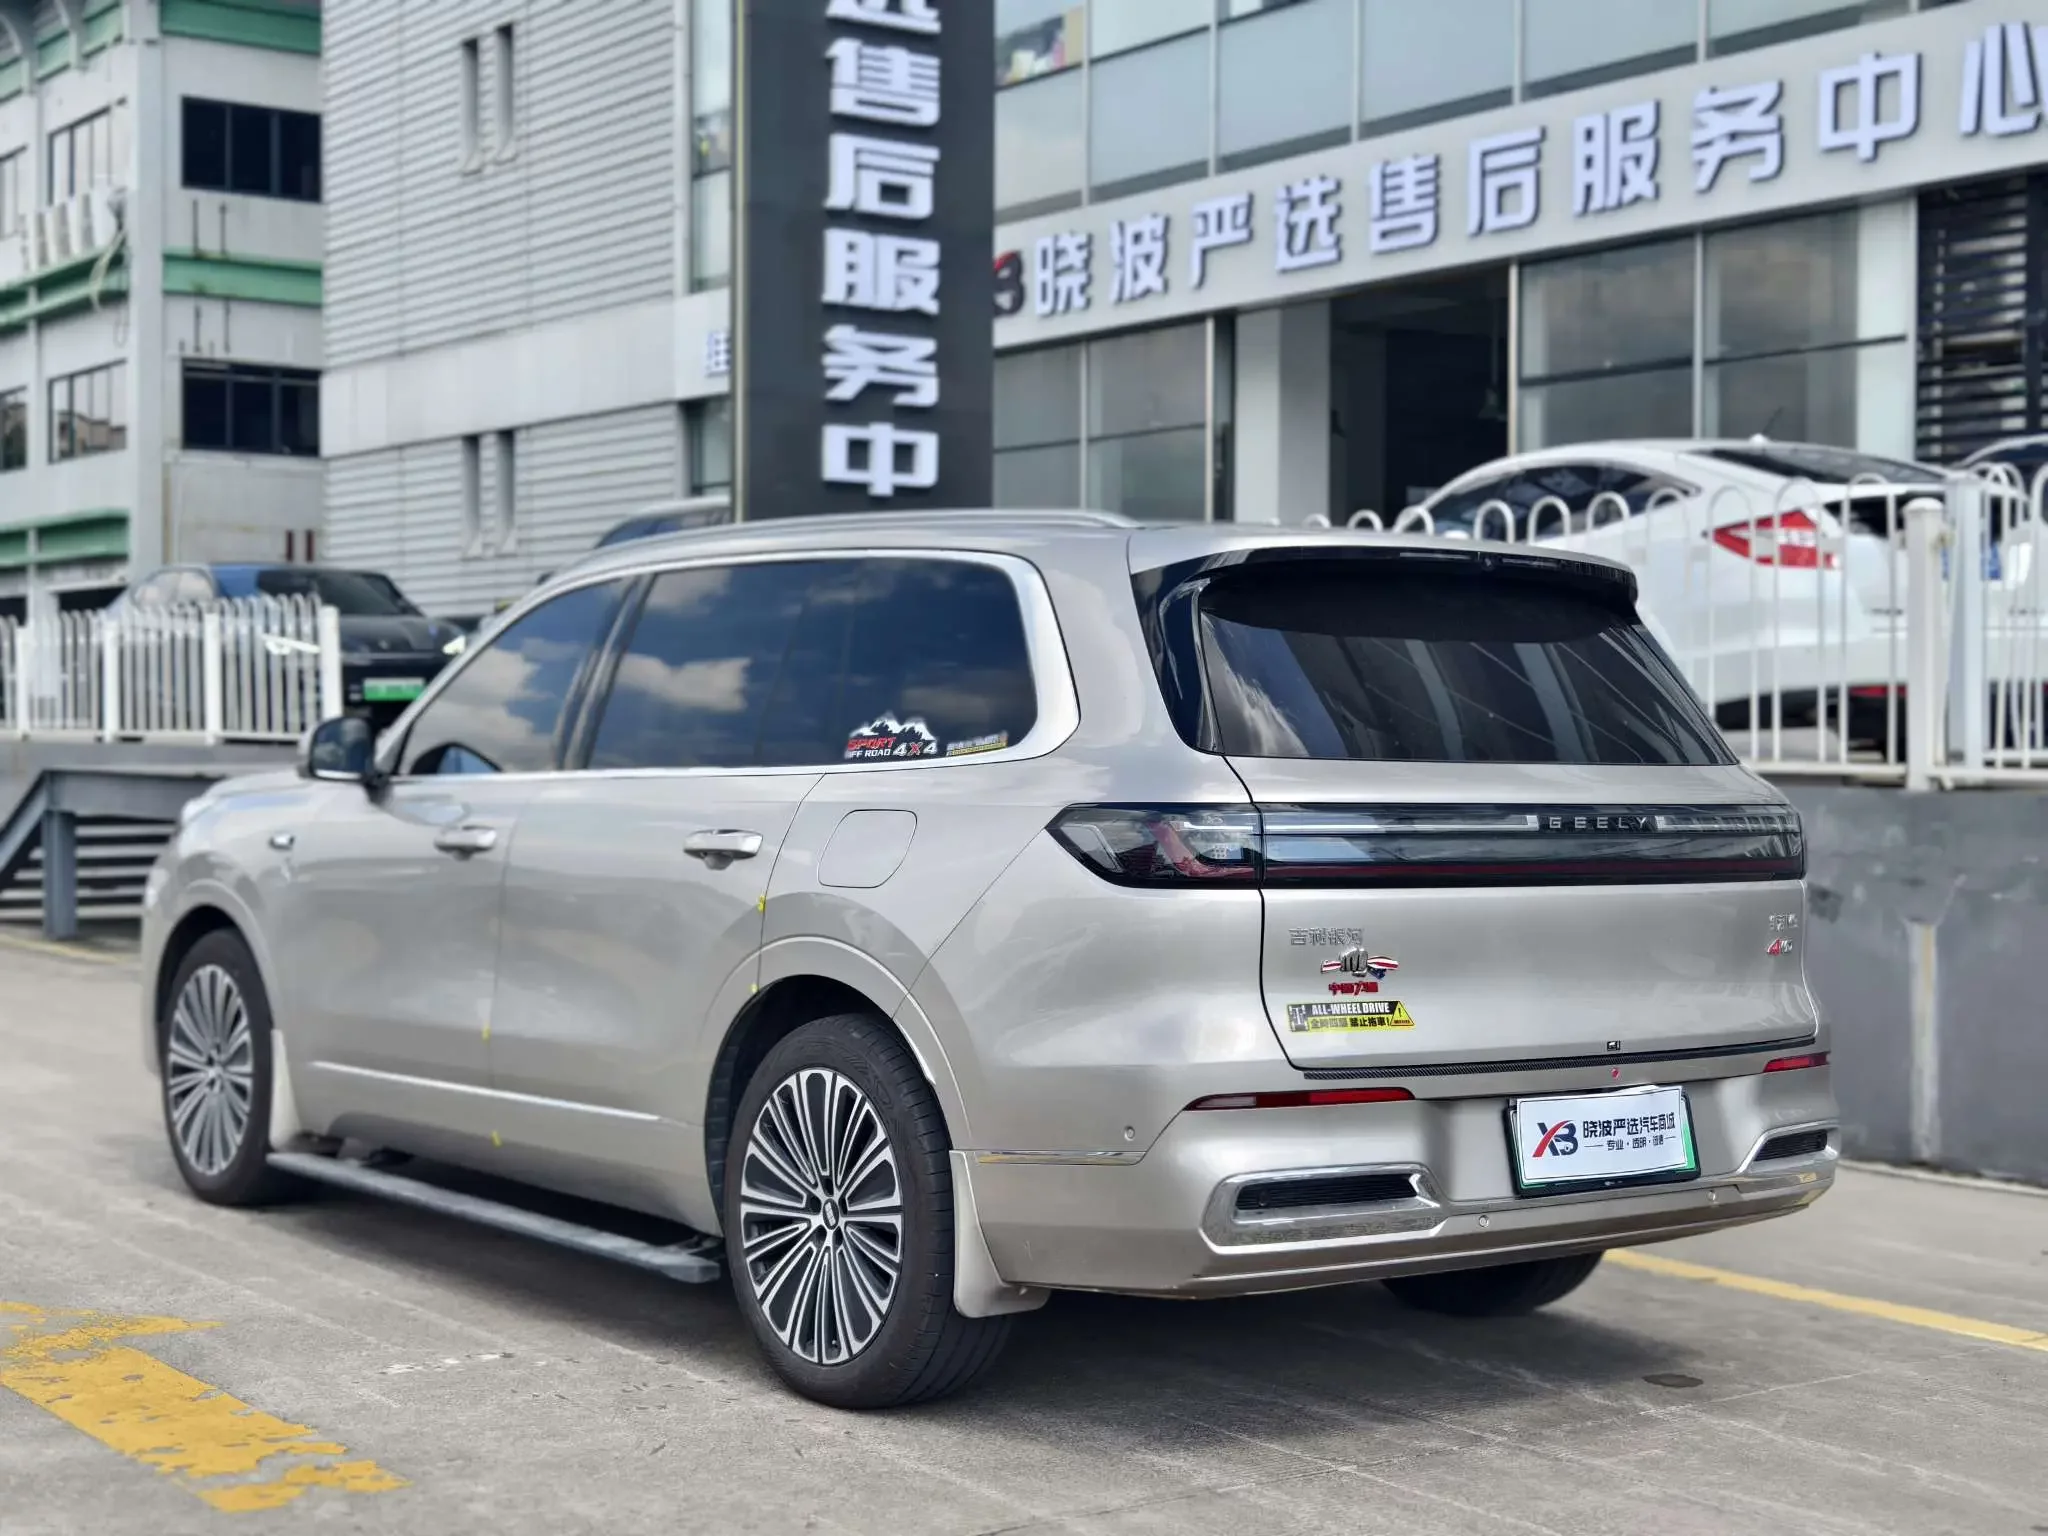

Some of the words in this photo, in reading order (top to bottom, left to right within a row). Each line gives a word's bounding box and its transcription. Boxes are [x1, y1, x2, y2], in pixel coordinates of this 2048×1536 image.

[1035, 20, 2048, 318] 晓波严选售后服务中心
[864, 749, 891, 757] ROAD
[1549, 815, 1648, 829] GEELY
[1311, 1003, 1362, 1016] ALL-WHEEL
[1362, 1002, 1391, 1014] DRIVE
